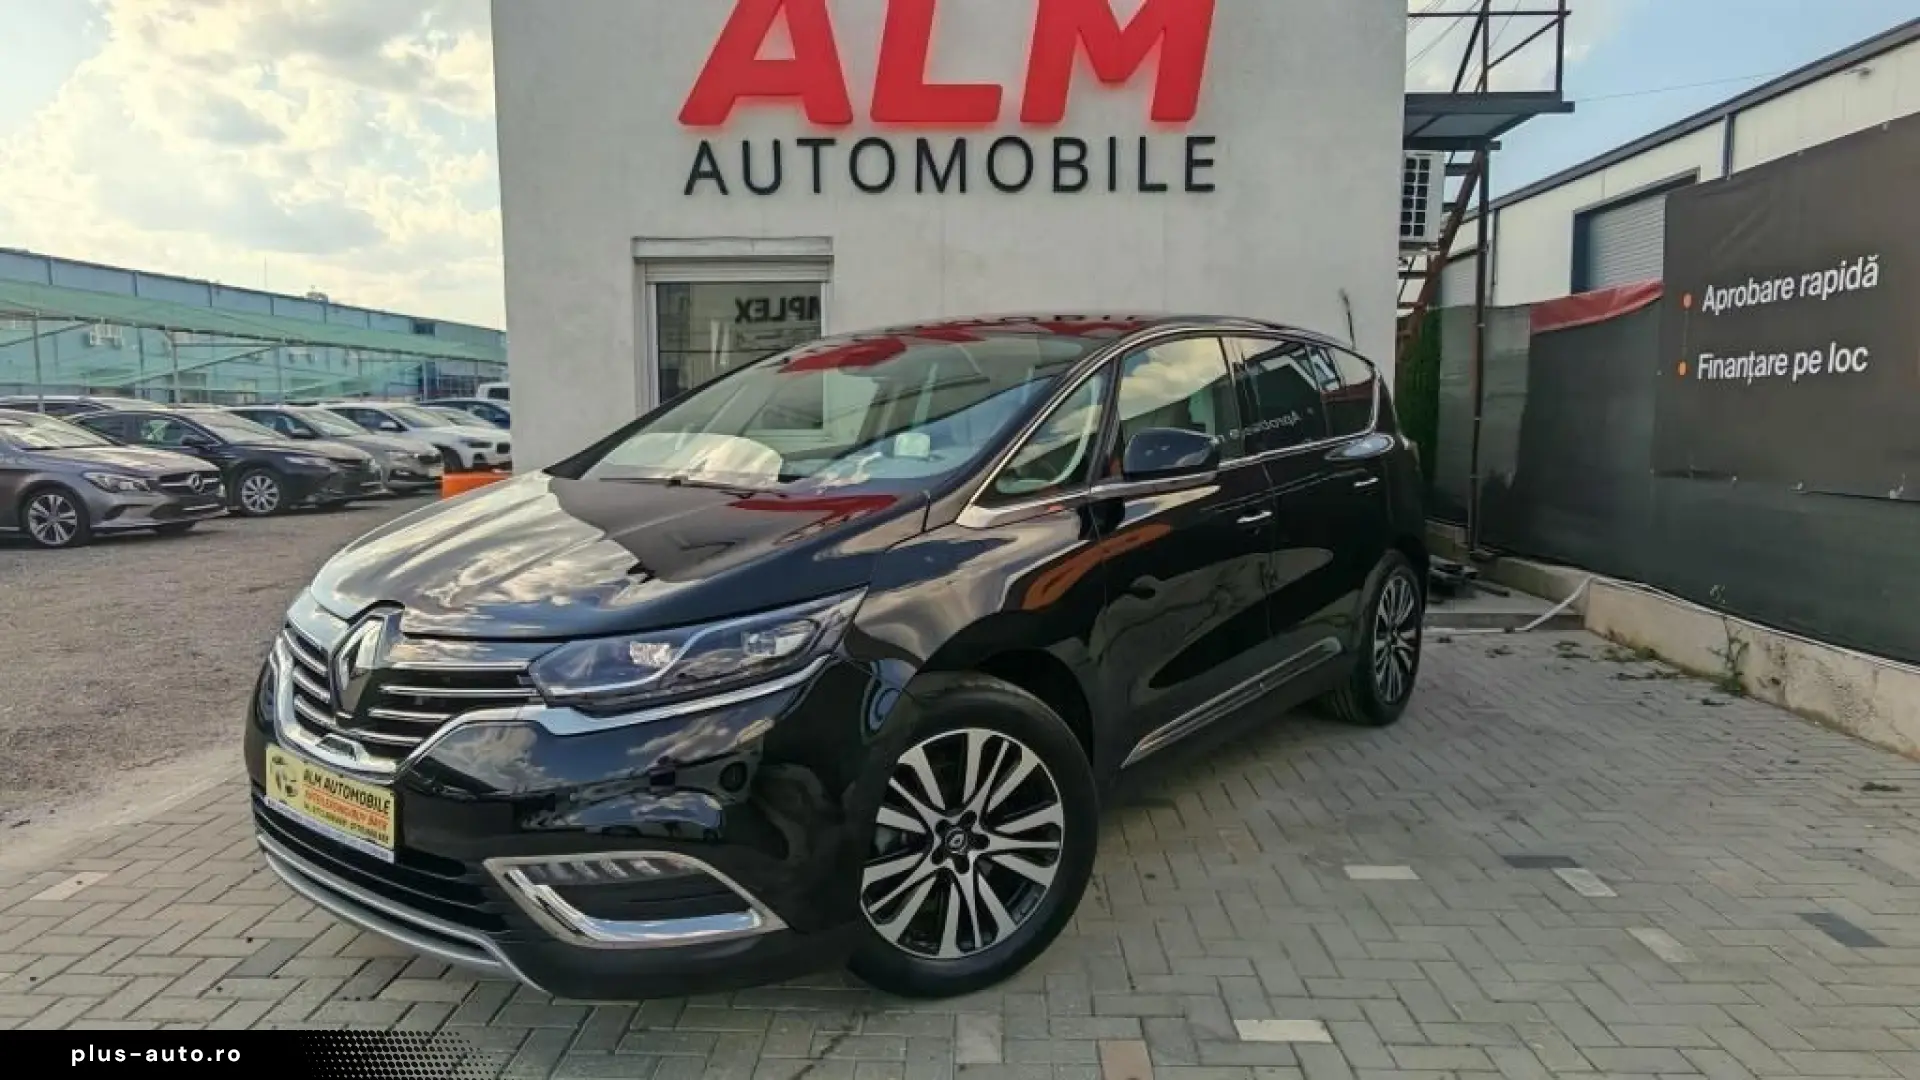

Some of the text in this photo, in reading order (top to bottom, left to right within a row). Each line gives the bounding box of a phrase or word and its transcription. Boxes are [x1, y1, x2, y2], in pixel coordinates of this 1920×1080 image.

[678, 0, 1216, 125] ALM
[684, 136, 1216, 195] AUTOMOBILE
[1702, 254, 1880, 315] Aprobare rapidă
[1698, 341, 1869, 385] Finanțare pe loc
[303, 768, 322, 788] ALM
[324, 777, 391, 814] AUTOMOBILE
